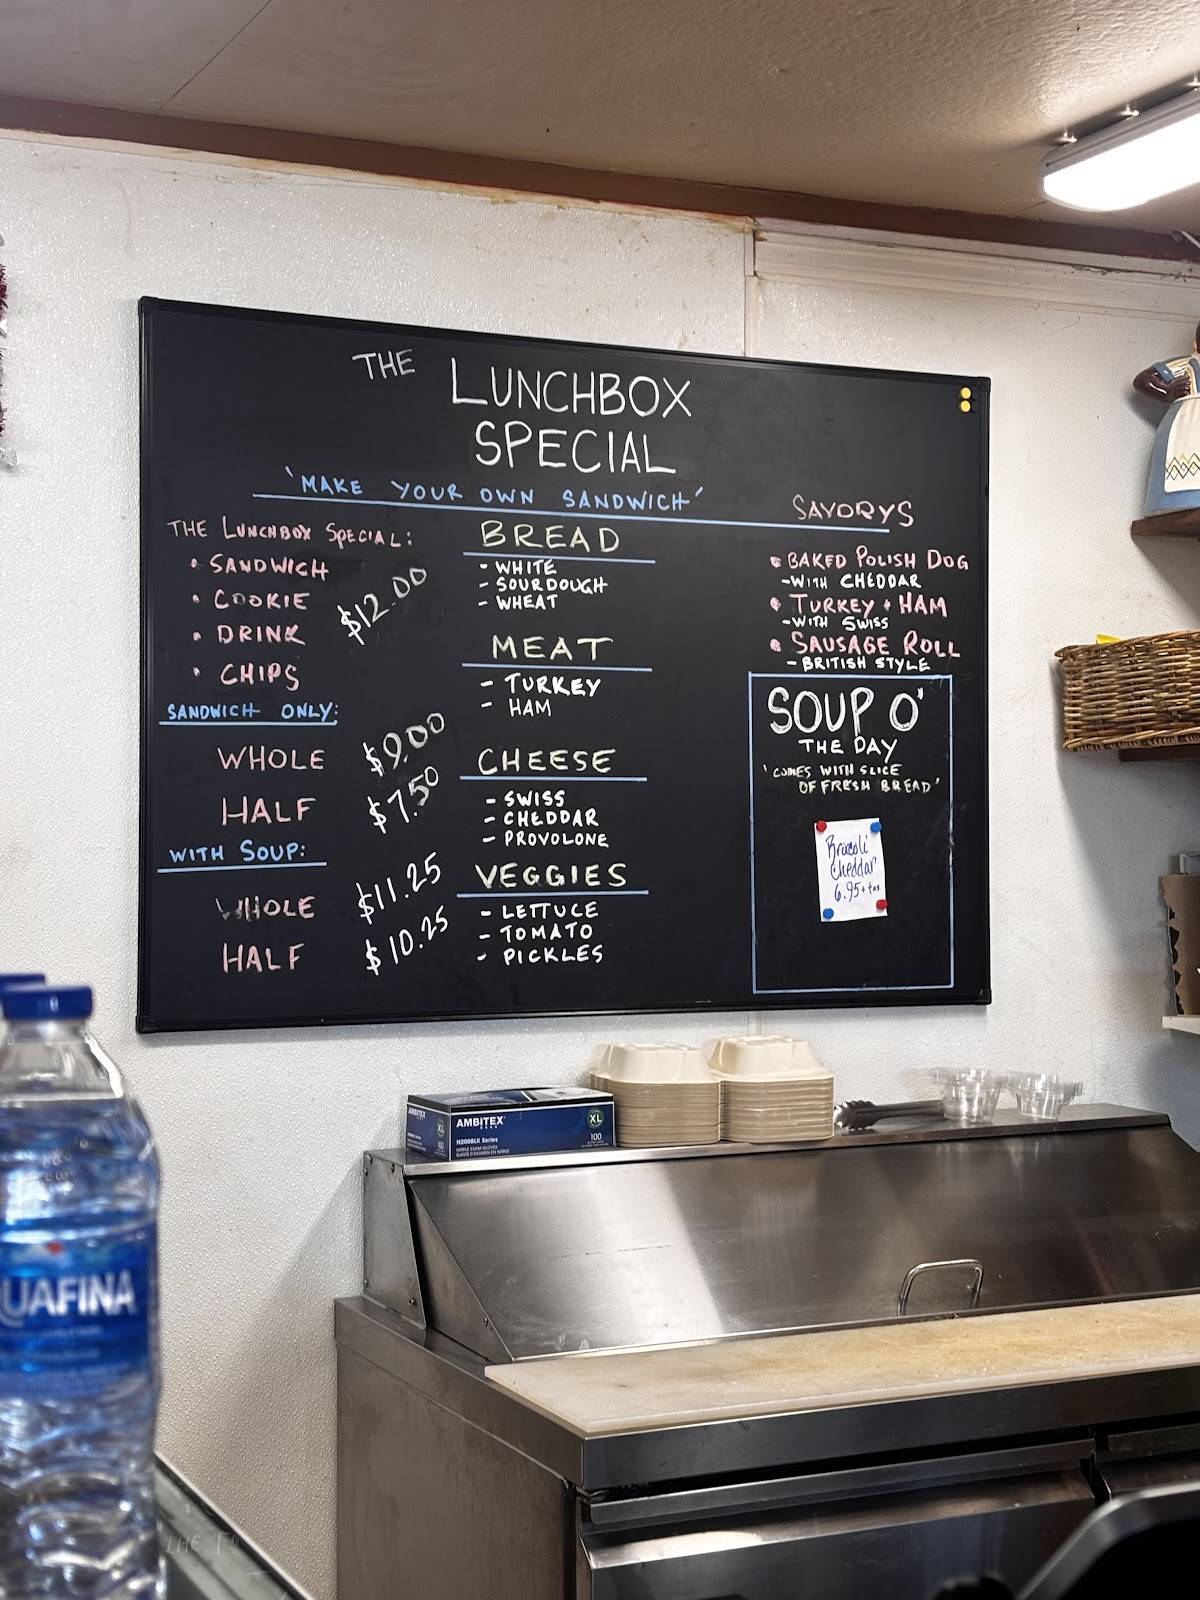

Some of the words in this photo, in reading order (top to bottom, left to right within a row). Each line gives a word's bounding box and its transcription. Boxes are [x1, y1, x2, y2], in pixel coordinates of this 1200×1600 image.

[352, 348, 416, 380] THE
[450, 357, 692, 418] LUNCHBOX
[475, 420, 677, 474] SPECIAL
[391, 481, 464, 502] YOUR
[480, 487, 535, 505] OWN
[793, 494, 915, 528] SAVORYS
[167, 519, 208, 539] THE
[222, 514, 313, 541] LUNCHBOX
[480, 519, 621, 553] BREAD
[209, 552, 330, 582] SANDWICH
[495, 558, 558, 576] WHITE
[787, 552, 848, 570] BAKED
[856, 544, 917, 570] POLISH
[927, 549, 970, 571] DOG
[496, 576, 609, 594] SOURDOUGH
[840, 572, 923, 590] CHEDDAR
[214, 588, 311, 611] COOKIE
[336, 567, 428, 646] $12.00
[496, 594, 560, 611] WHEAT
[789, 592, 876, 620] TURKEY
[899, 591, 949, 618] HAM
[217, 623, 307, 646] DRINK
[842, 615, 890, 632] SWISS
[491, 634, 615, 662] MEAT
[791, 630, 891, 655] SAUSAGE
[902, 629, 962, 659] ROLL
[220, 662, 301, 692] CHIPS
[801, 655, 867, 673] BRITISH
[875, 656, 931, 675] STYLE
[504, 671, 602, 697] TURKEY
[167, 702, 261, 721] SANDWICH
[281, 701, 339, 723] ONLY:
[508, 697, 553, 718] HAM
[767, 685, 876, 737] SOUP
[888, 687, 925, 733] O'
[217, 744, 326, 772] WHOLE
[363, 712, 446, 778] $9.00
[798, 738, 845, 756] THE
[854, 735, 899, 765] DAY
[477, 748, 617, 776] CHEESE
[819, 763, 855, 778] WITH
[859, 763, 904, 777] SLICE
[367, 765, 441, 835] $7.50
[503, 788, 567, 809] SWISS
[798, 779, 818, 795] OF
[820, 778, 872, 796] FRESH
[221, 795, 317, 827] HALF
[503, 807, 601, 828] CHEDDAR
[168, 844, 225, 864] WITH
[239, 838, 306, 862] SOUP:
[504, 830, 611, 849] PROVOLONE
[355, 851, 443, 926] $11.25
[474, 861, 628, 890] VEGGIES
[501, 900, 600, 920] LETTUCE
[364, 904, 450, 977] $10.25
[499, 921, 594, 944] TOMATO
[222, 941, 305, 974] HALF
[502, 943, 604, 966] PICKLES
[456, 1115, 504, 1128] AMBITEX
[589, 1113, 603, 1124] XL
[590, 1132, 602, 1142] 100
[0, 1267, 138, 1326] UAFINA
